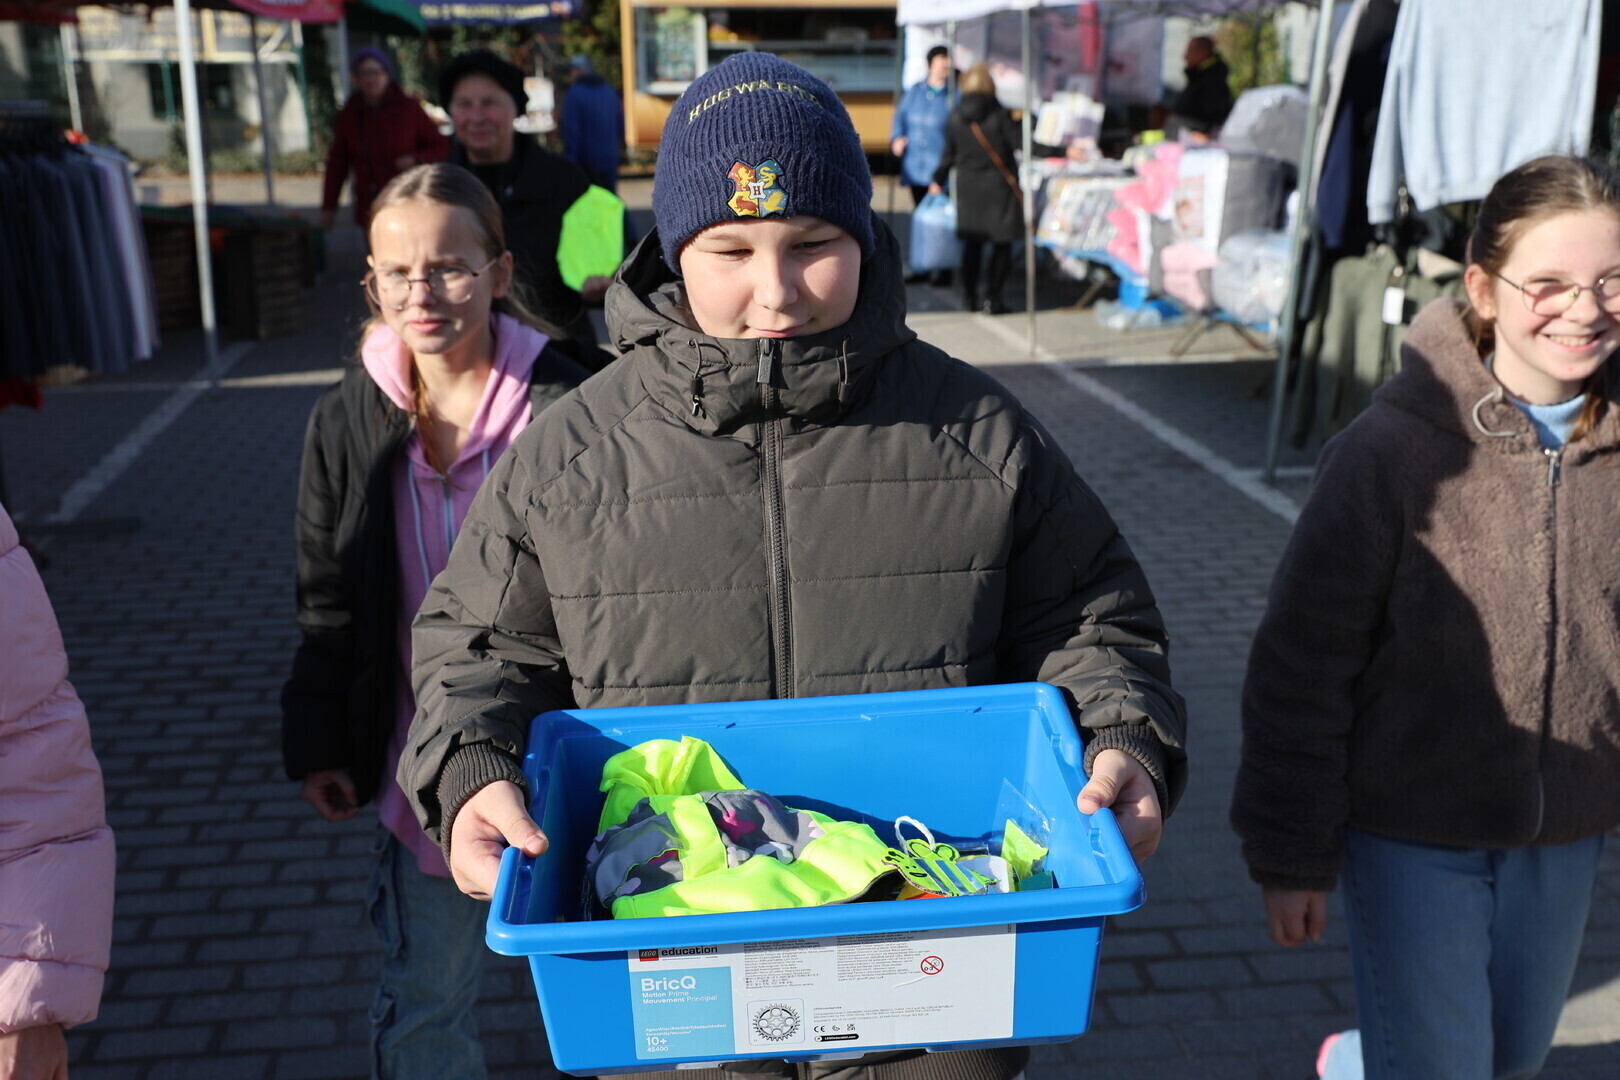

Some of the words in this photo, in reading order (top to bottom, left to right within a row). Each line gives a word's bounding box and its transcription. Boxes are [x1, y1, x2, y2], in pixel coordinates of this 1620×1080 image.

[753, 185, 761, 195] H
[661, 946, 718, 956] education
[641, 975, 696, 992] BricQ
[643, 997, 685, 1005] Mouvement
[686, 994, 718, 1004] Principal
[646, 1036, 668, 1046] 10+
[647, 1045, 669, 1053] 45400
